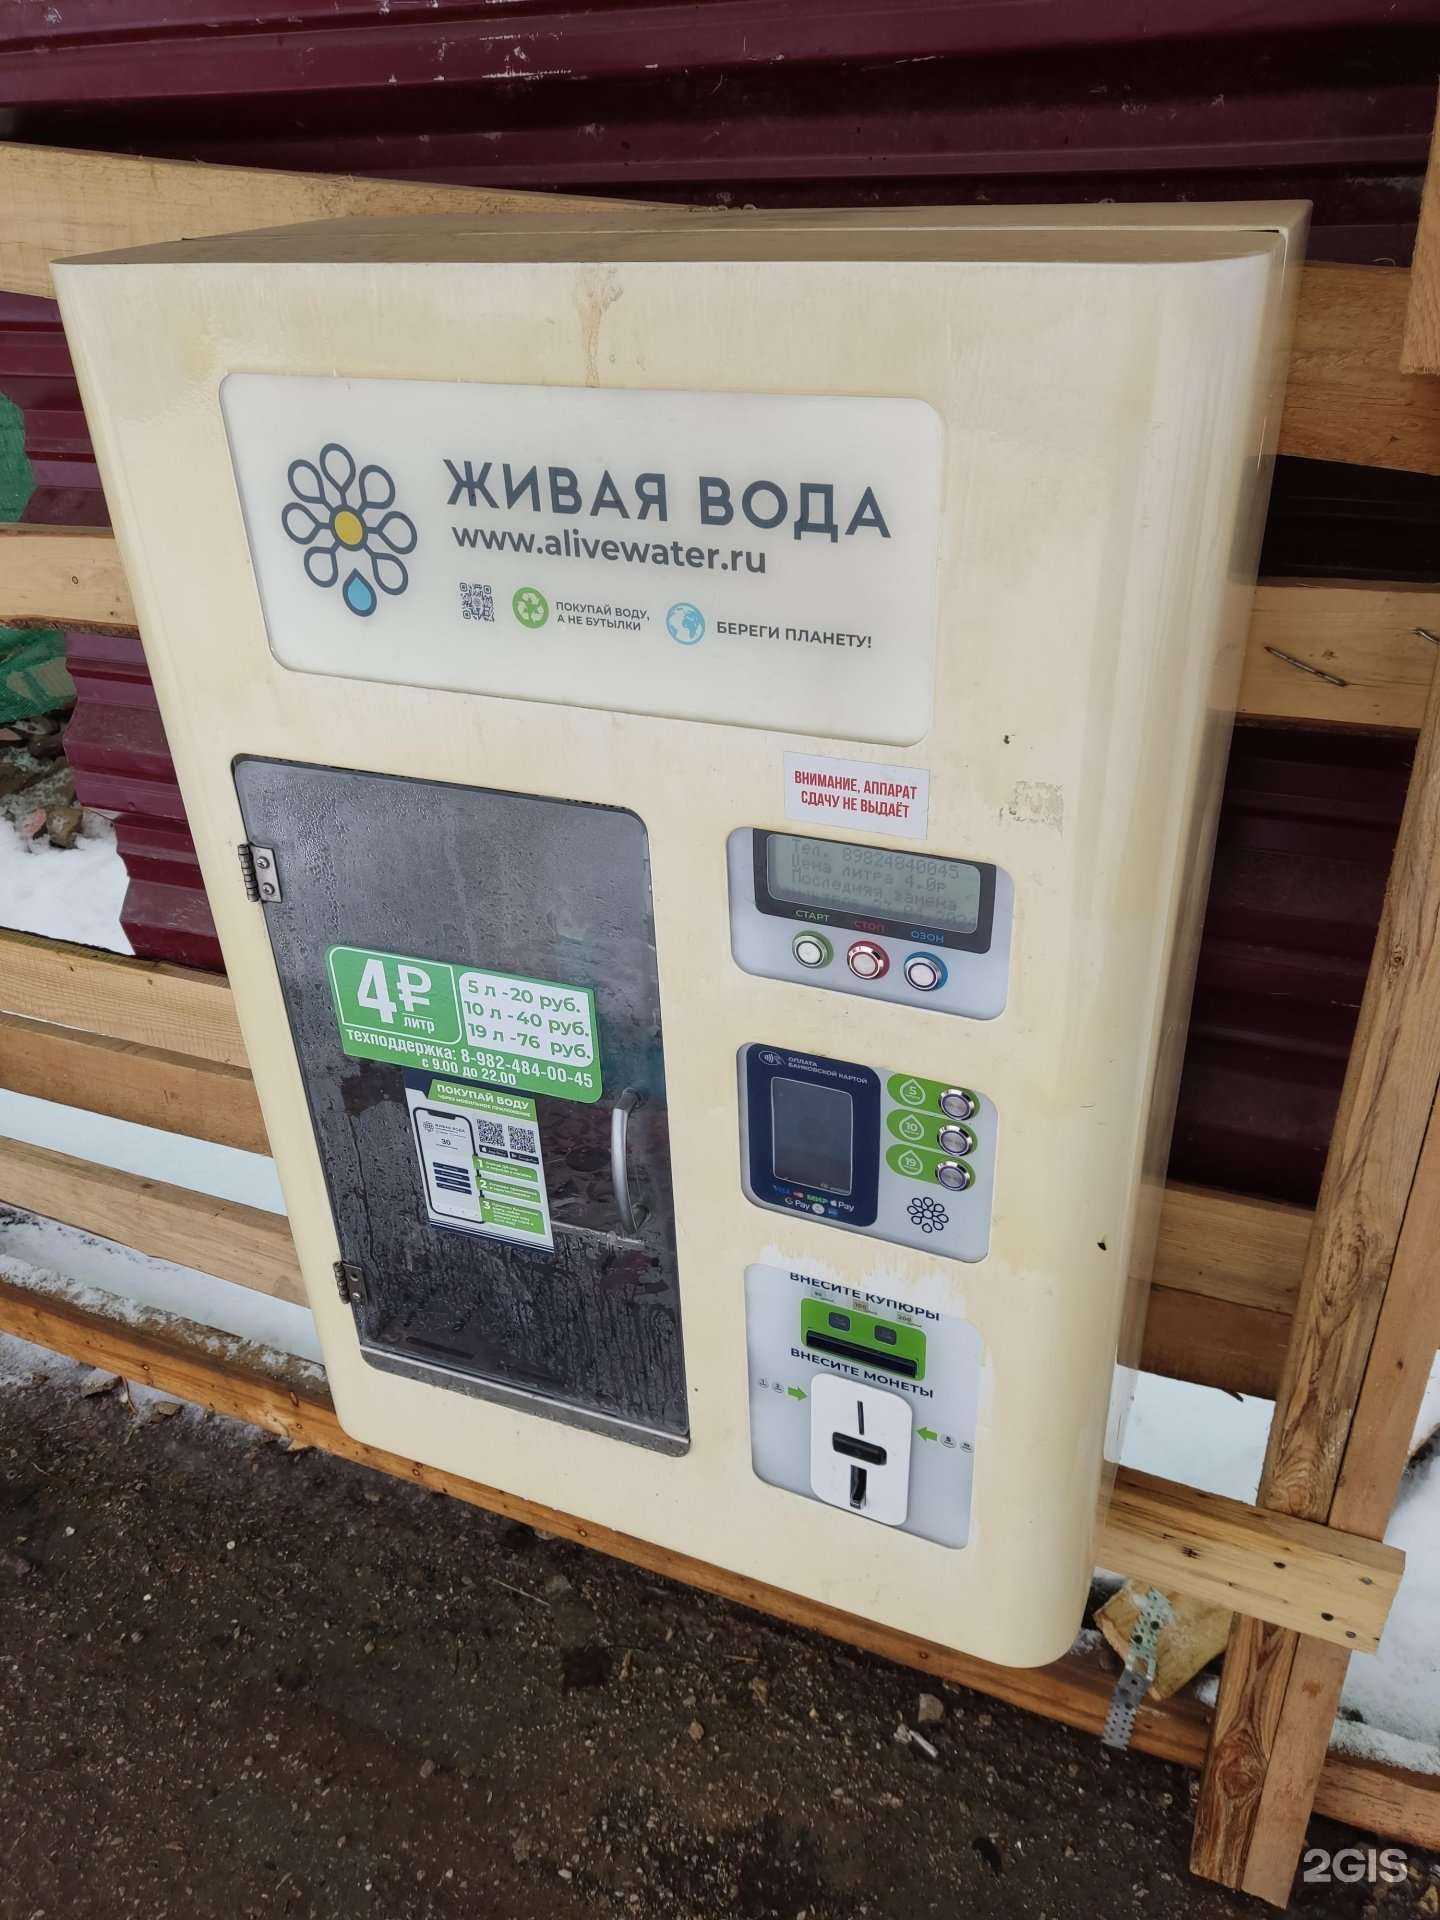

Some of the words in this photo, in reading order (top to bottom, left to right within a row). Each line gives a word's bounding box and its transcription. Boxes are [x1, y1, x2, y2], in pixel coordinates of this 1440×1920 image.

[442, 458, 668, 522] ЖИВАЯ
[699, 476, 892, 542] ВОДА
[452, 527, 767, 574] www.alivewater.ru
[556, 601, 611, 617] ПОКУПАЙ
[616, 607, 650, 621] ВОДУ,
[557, 614, 565, 624] А
[568, 615, 583, 625] НЕ
[586, 616, 641, 631] БУТЫЛКИ
[717, 621, 780, 641] БЕРЕГИ
[785, 629, 872, 649] ПЛАНЕТУ!
[795, 771, 860, 793] ВНИМАНИЕ,
[864, 780, 917, 799] АППАРАТ
[801, 791, 840, 807] СДАЧУ
[843, 797, 857, 811] НЕ
[861, 799, 909, 818] ВЫДАЁТ
[843, 849, 960, 879] 89824840045
[795, 910, 830, 922] СТАРТ
[854, 920, 885, 933] СТОП
[911, 930, 945, 944] ОЗОН
[468, 980, 479, 994] 5
[484, 985, 496, 998] л
[540, 994, 581, 1013] руб.
[403, 1016, 434, 1033] литр
[464, 1000, 484, 1016] 10
[490, 1008, 502, 1020] л
[548, 1018, 589, 1037] руб.
[468, 1023, 487, 1038] 19
[493, 1029, 504, 1042] л
[550, 1040, 591, 1060] руб.
[422, 1059, 429, 1068] с
[433, 1058, 458, 1075] 9.00
[462, 1066, 478, 1079] до
[481, 1068, 517, 1086] 22.00
[461, 1049, 593, 1088] 8-982-484-00-45
[788, 1056, 817, 1067] ОПЛАТА
[788, 1063, 837, 1077] БАНКОВСКОЙ
[839, 1073, 868, 1084] КАРТОЙ
[437, 1084, 494, 1103] ПОКУПАЙ
[496, 1096, 529, 1110] ВОДУ
[478, 1159, 484, 1168] 1
[480, 1180, 488, 1189] 2
[483, 1200, 490, 1209] 3
[795, 1200, 810, 1210] Pay
[838, 1202, 854, 1212] Pay
[790, 1272, 861, 1299] ВНЕСИТЕ
[865, 1292, 940, 1321] КУПЮРЫ
[790, 1348, 859, 1376] ВНЕСИТЕ
[864, 1370, 934, 1398] МОНЕТЫ
